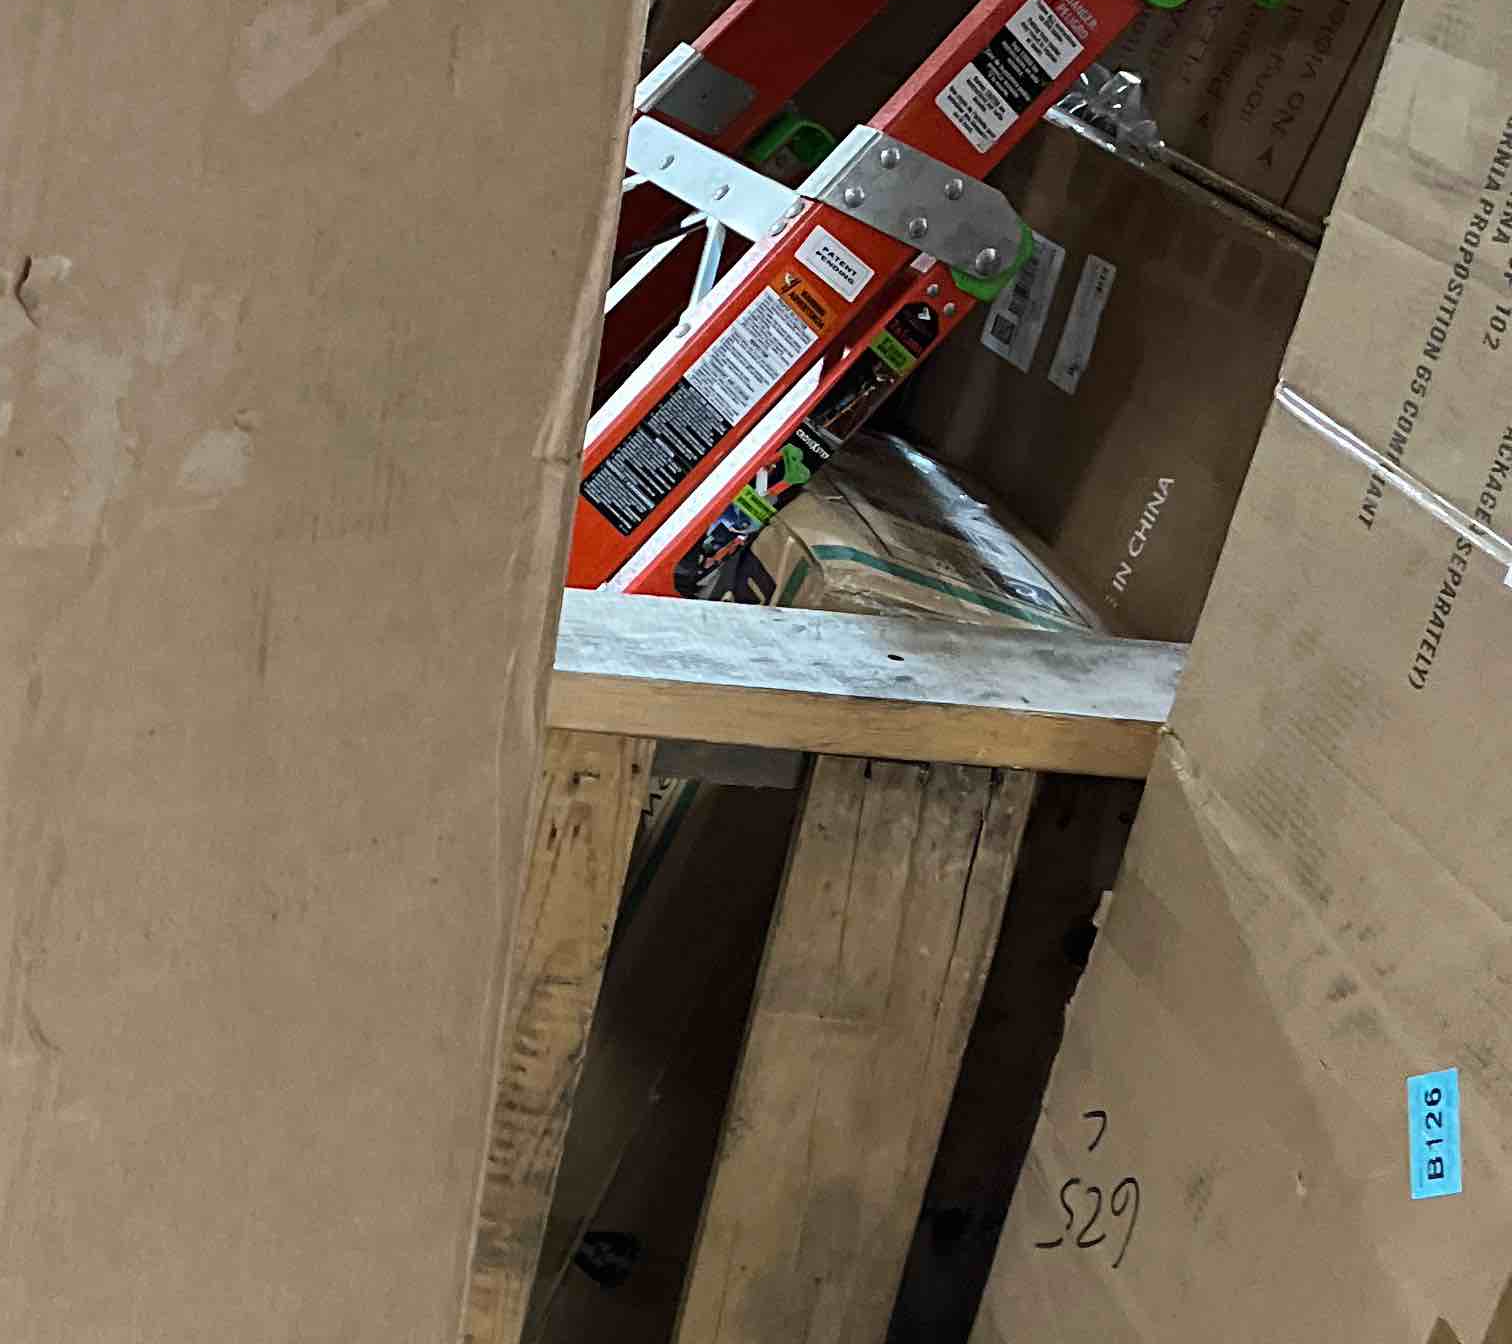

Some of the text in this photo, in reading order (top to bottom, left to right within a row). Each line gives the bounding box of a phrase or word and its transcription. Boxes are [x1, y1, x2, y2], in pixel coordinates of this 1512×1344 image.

[815, 250, 855, 286] PENDING
[822, 246, 858, 277] PATENT
[1423, 197, 1495, 360] PROPOSITION
[1410, 365, 1432, 398] 65
[1113, 476, 1176, 591] IN CHINA
[1407, 536, 1473, 691] SEPARATELY)
[1423, 1085, 1447, 1184] B126
